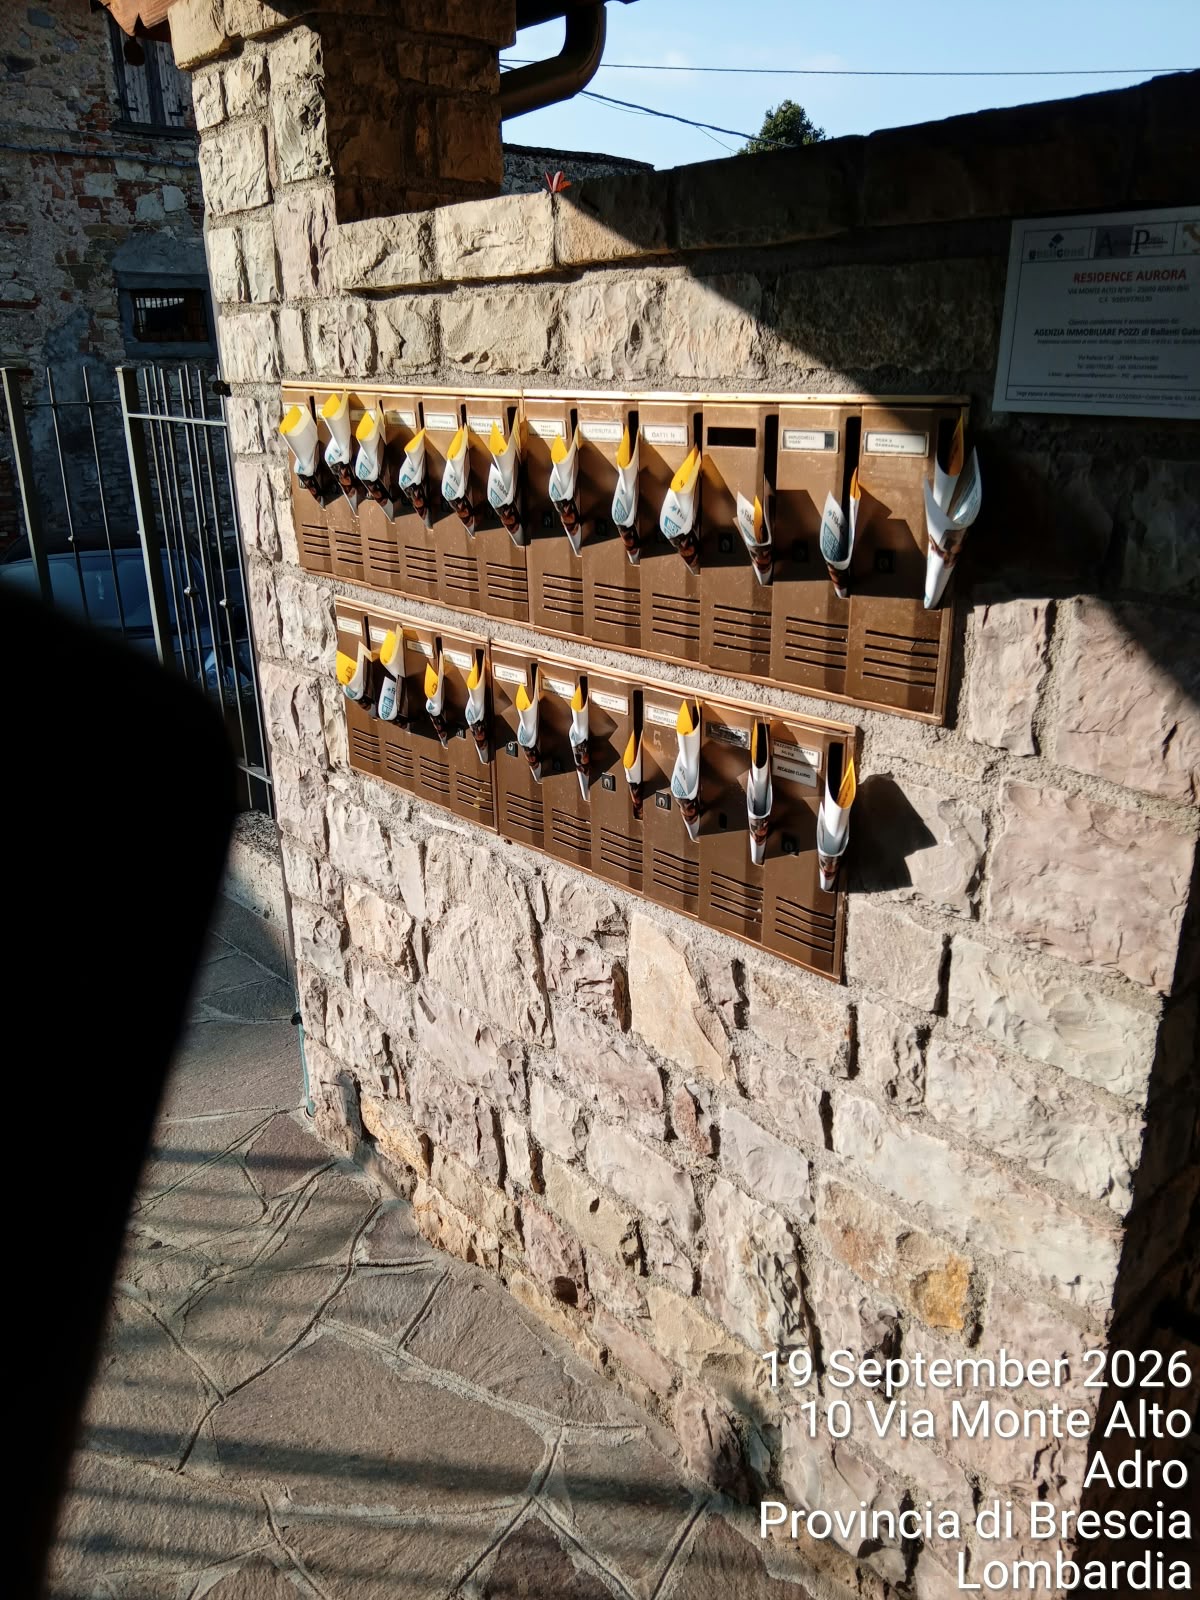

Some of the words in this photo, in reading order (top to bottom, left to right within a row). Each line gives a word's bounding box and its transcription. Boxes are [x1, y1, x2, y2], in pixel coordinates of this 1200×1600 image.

[1073, 271, 1133, 284] RESIDENCE
[1136, 268, 1186, 281] AURORA
[1034, 328, 1064, 337] AGENZIA
[1066, 328, 1116, 337] IMMOBILIARE
[1118, 328, 1140, 337] POZZI
